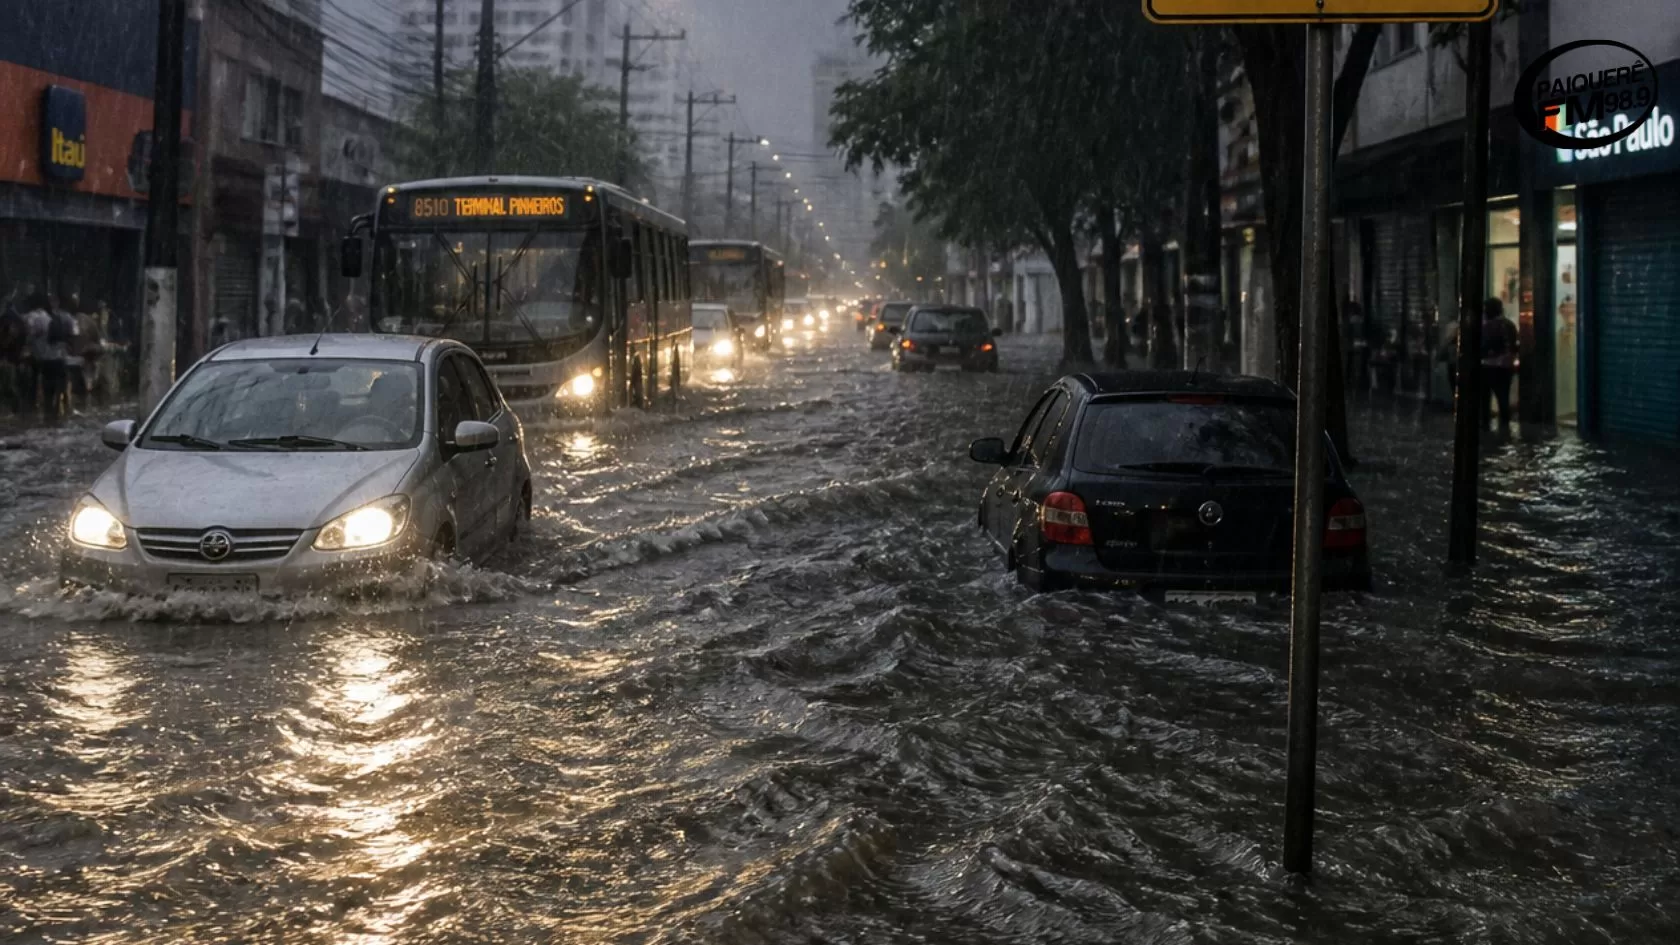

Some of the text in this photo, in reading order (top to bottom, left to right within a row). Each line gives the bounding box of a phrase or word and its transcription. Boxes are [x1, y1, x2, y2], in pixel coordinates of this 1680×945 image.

[51, 127, 85, 168] Itaú
[1613, 106, 1674, 155] Paulo
[414, 197, 449, 216] 8510
[454, 197, 506, 216] TERMINAL
